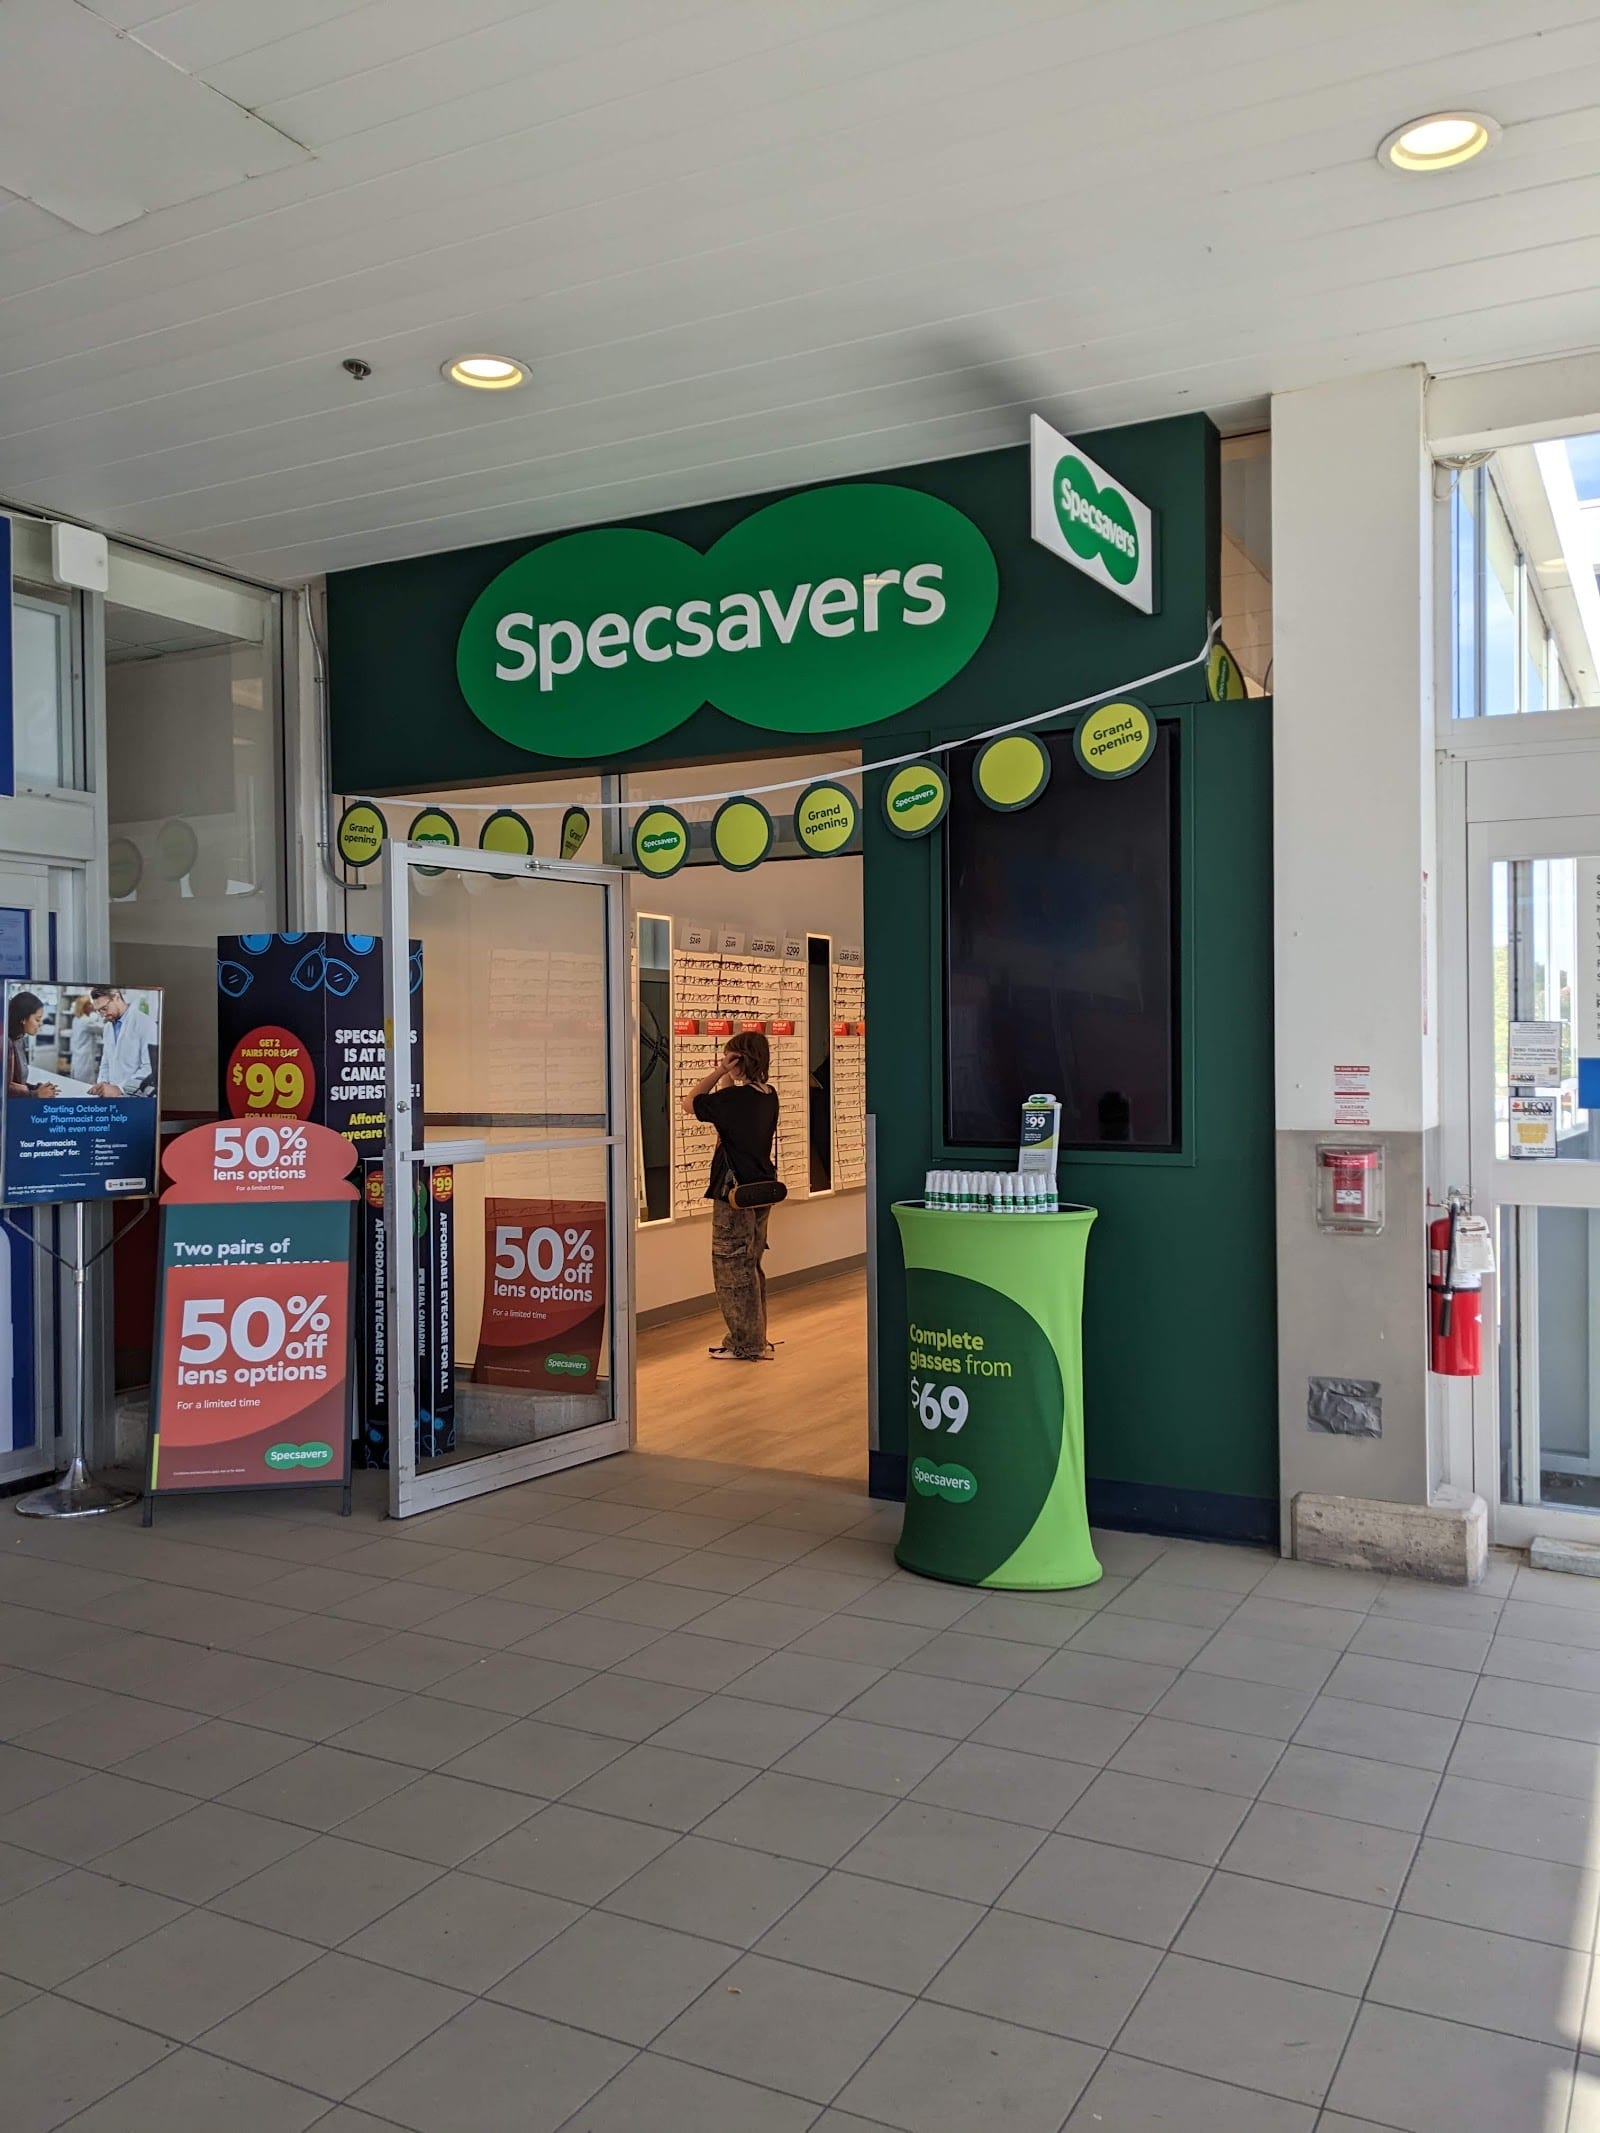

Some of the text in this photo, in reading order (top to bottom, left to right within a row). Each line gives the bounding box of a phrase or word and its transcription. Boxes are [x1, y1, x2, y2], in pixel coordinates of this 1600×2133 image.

[1061, 478, 1136, 558] Specsavers
[496, 563, 945, 691] Specsavers
[1092, 718, 1133, 741] Grand
[1090, 729, 1142, 756] opening
[895, 788, 934, 809] Specsavers
[808, 804, 841, 821] Grand
[349, 823, 374, 834] Grand
[805, 816, 848, 835] opening
[344, 834, 377, 846] opening
[643, 836, 678, 848] Specsavers
[786, 946, 800, 957] $299
[259, 1039, 281, 1048] GET 2
[335, 1029, 417, 1044] SPECSAS
[241, 1049, 263, 1057] PAIRS
[264, 1049, 280, 1057] FOR
[344, 1049, 357, 1062] IS
[358, 1048, 377, 1062] AT
[232, 1062, 305, 1109] $99
[30, 1115, 48, 1124] Your
[50, 1114, 93, 1123] Pharmacist
[111, 1113, 128, 1123] help
[43, 1105, 74, 1115] Starting
[76, 1105, 107, 1113] October
[49, 1125, 66, 1133] with
[88, 1124, 111, 1132] more!
[1025, 1116, 1046, 1128] $99
[20, 1139, 77, 1148] Your Pharmacists
[213, 1126, 308, 1168] 50% off
[213, 1166, 306, 1182] lens options
[432, 1176, 453, 1192] $99
[173, 1238, 291, 1258] Two pairs of
[494, 1225, 594, 1284] 50% off
[493, 1279, 593, 1303] lens options
[375, 1218, 385, 1405] AFFORDABLE EYECARE FOR ALL
[440, 1212, 449, 1394] AFFORDABLE EYECARE FOR ALL
[493, 1309, 503, 1317] For
[510, 1309, 531, 1319] limited
[532, 1310, 547, 1320] time
[179, 1295, 330, 1365] 50% off
[909, 1323, 984, 1351] Complete
[548, 1358, 587, 1370] Specsavers
[909, 1349, 1013, 1377] glasses from
[177, 1361, 327, 1387] lens options
[177, 1401, 194, 1410] For
[204, 1399, 237, 1409] limited
[239, 1398, 261, 1407] time
[911, 1376, 969, 1434] $69
[270, 1449, 328, 1462] Specsavers
[914, 1467, 971, 1491] Specsavers
